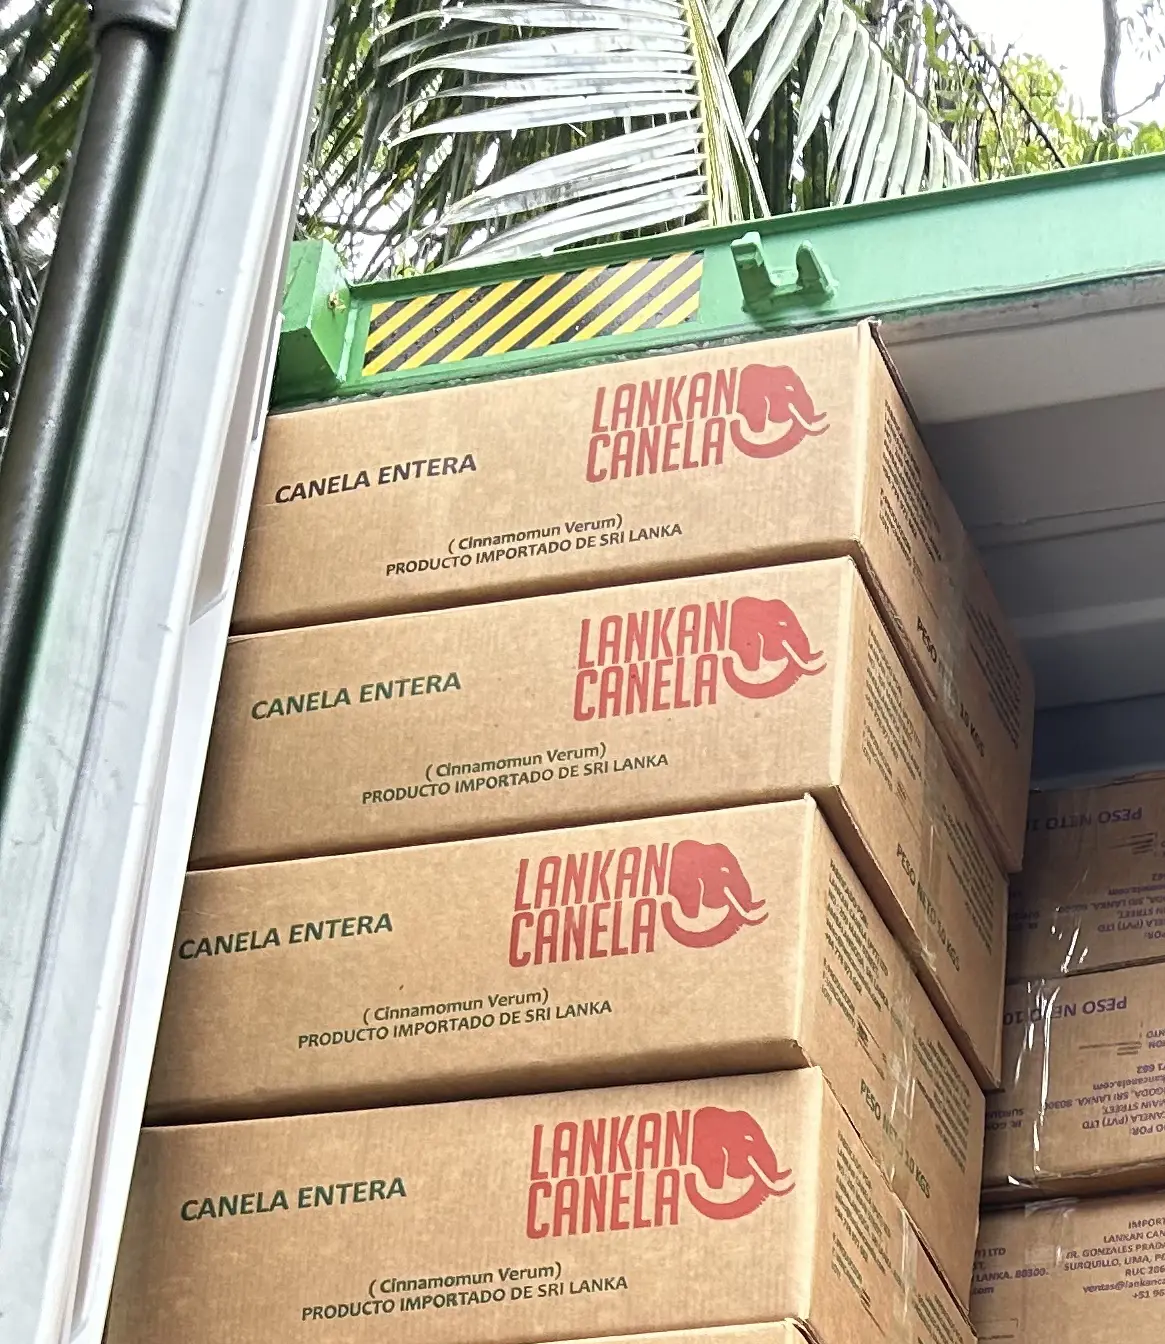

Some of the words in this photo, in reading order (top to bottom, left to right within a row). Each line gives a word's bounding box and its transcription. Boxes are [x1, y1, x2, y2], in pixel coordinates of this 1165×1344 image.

[593, 369, 737, 434] LANKAN
[274, 469, 371, 505] CANELA
[377, 453, 477, 486] ENTERA
[587, 417, 727, 482] CANELA
[580, 601, 728, 667] LANKAN
[251, 686, 352, 722] CANELA
[359, 670, 462, 704] ENTERA
[574, 654, 719, 722] CANELA
[362, 781, 451, 805] PRODUCTO
[454, 767, 554, 795] IMPORTADO
[558, 763, 580, 781] DE
[583, 759, 609, 777] SRI
[613, 753, 669, 774] LANKA
[514, 844, 669, 912] LANKAN
[178, 928, 281, 961] CANELA
[288, 912, 393, 945] ENTERA
[509, 898, 656, 967] CANELA
[531, 1111, 691, 1182] LANKAN
[180, 1189, 289, 1223] CANELA
[297, 1176, 407, 1210] ENTERA
[527, 1169, 681, 1240] CANELA
